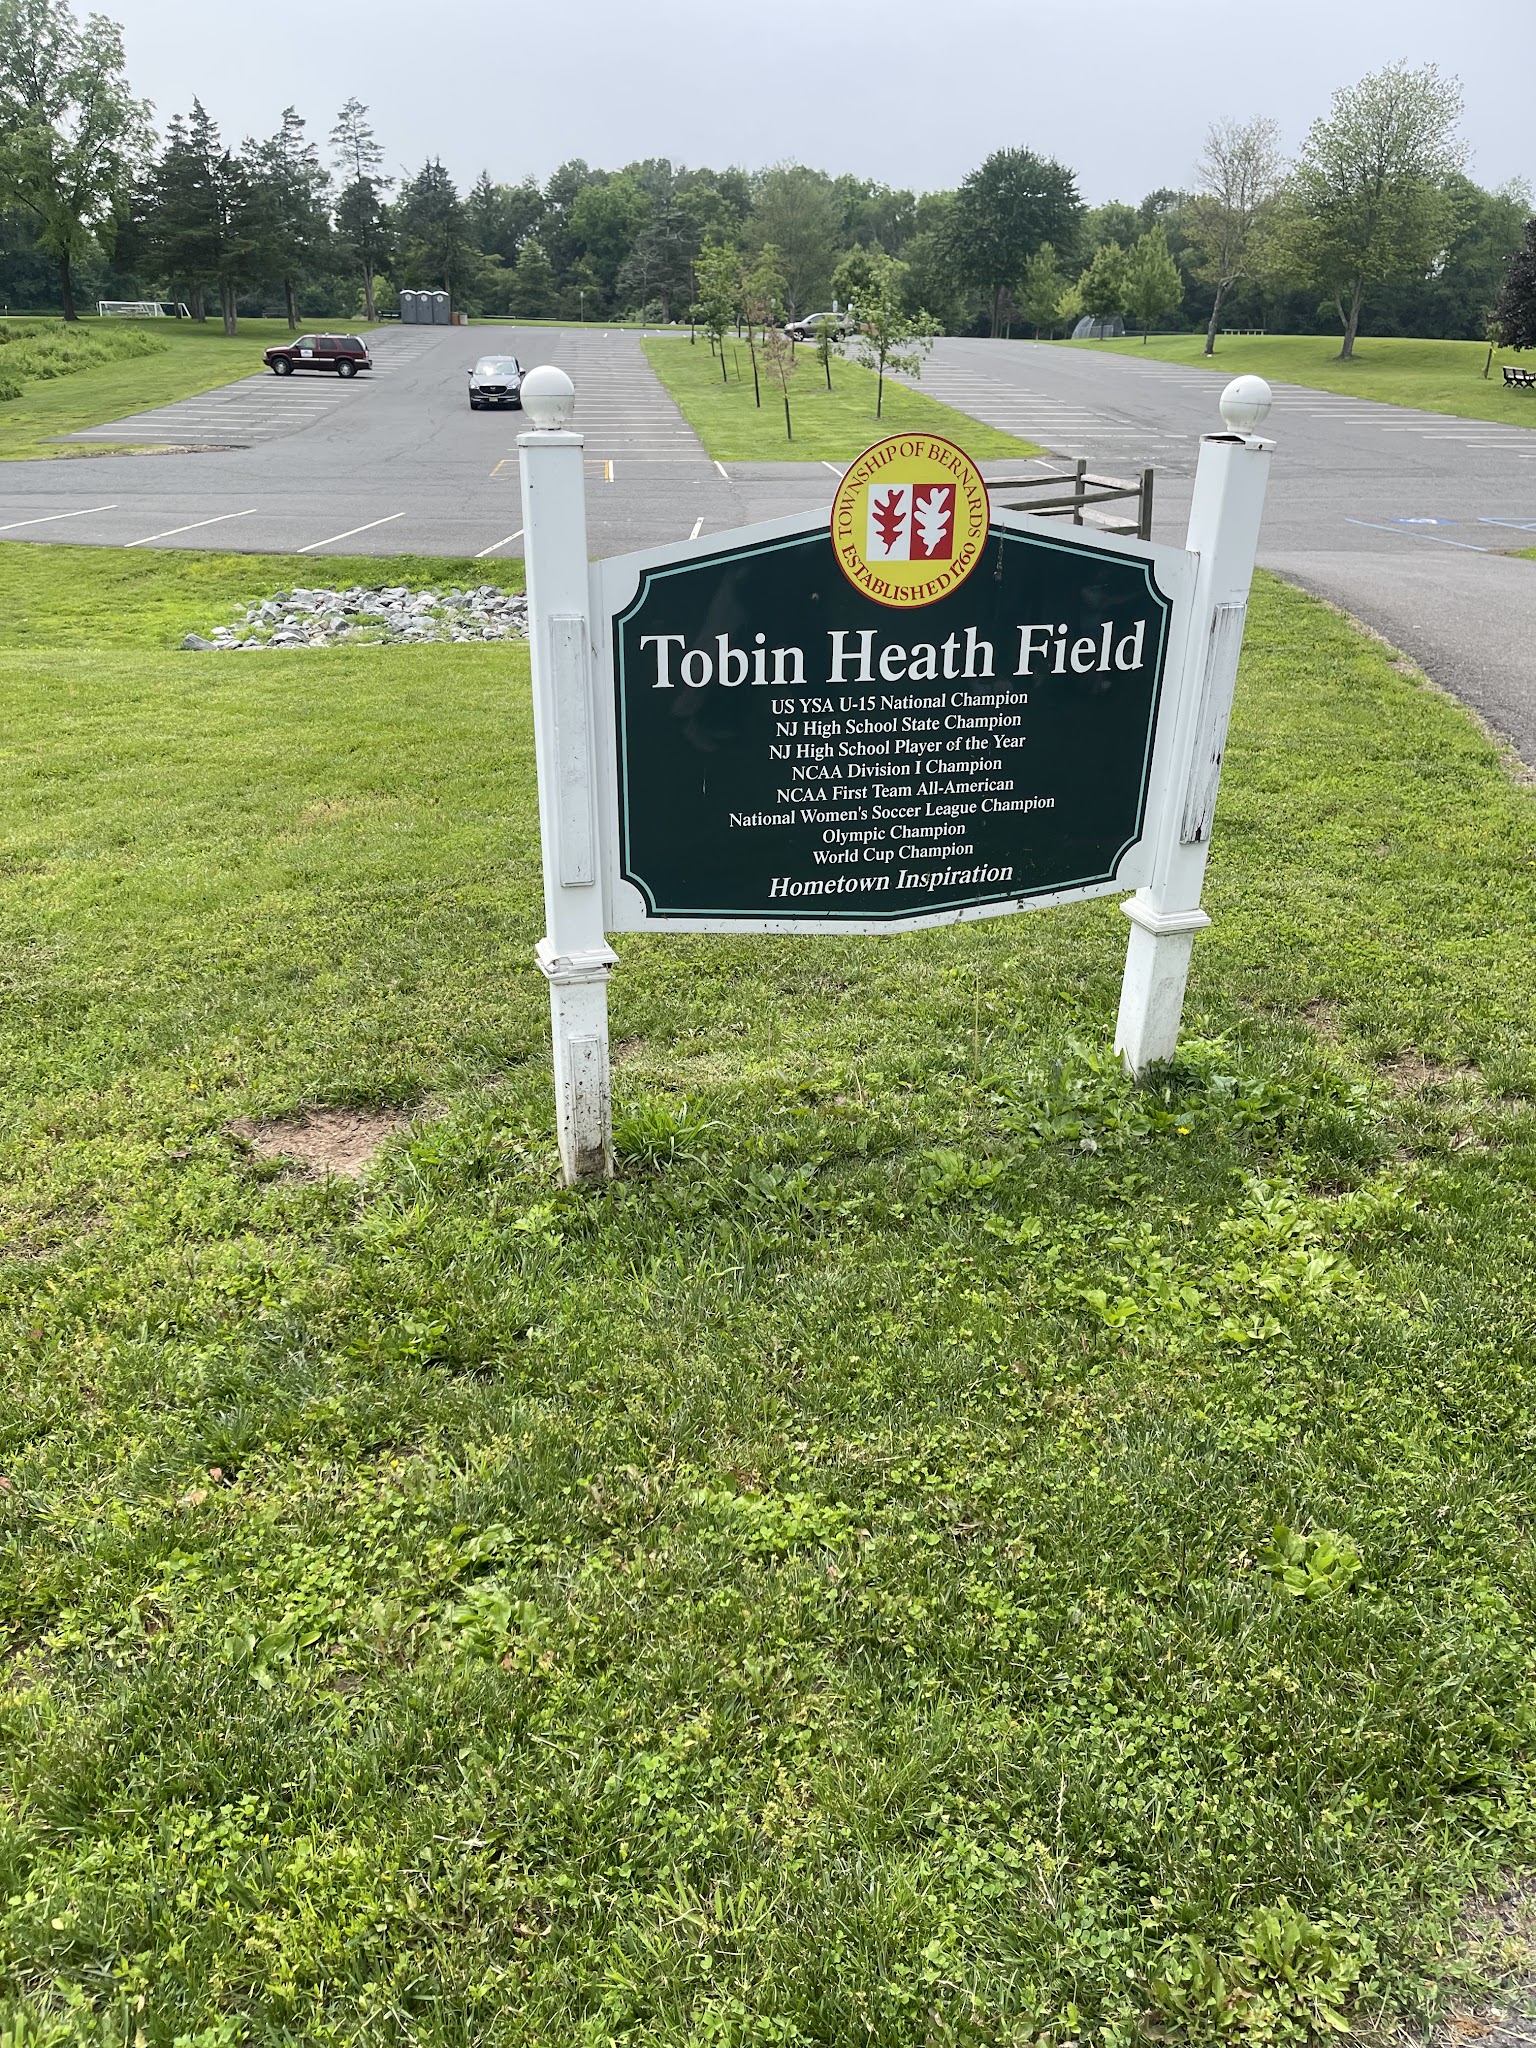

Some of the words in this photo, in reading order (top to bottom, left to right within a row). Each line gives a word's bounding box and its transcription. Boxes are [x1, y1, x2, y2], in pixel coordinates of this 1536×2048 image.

[838, 445, 896, 540] TOWNSHIP
[900, 441, 925, 458] OF
[927, 443, 983, 539] BERNARDS
[841, 543, 951, 601] ESTABLISHED
[949, 542, 976, 579] 1760
[640, 633, 807, 688] Tobin
[826, 627, 995, 682] Heath
[1013, 620, 1145, 675] Field
[772, 699, 794, 714] US
[799, 698, 834, 713] YSA
[840, 696, 875, 711] U-15
[881, 693, 945, 710] National
[951, 691, 1027, 708] Champion
[776, 722, 798, 736] NJ
[804, 720, 841, 738] High
[846, 718, 897, 734] School
[902, 717, 939, 731] State
[945, 713, 1021, 731] Champion
[770, 745, 791, 759] NJ
[796, 743, 833, 761] High
[839, 740, 889, 756] School
[895, 739, 942, 756] Player
[946, 737, 963, 751] of
[965, 736, 988, 750] the
[993, 735, 1026, 748] Year
[792, 765, 842, 780] NCAA
[848, 762, 910, 777] Division
[915, 761, 921, 774] I
[926, 757, 1001, 774] Champion
[777, 788, 827, 803] NCAA
[833, 786, 867, 800] First
[872, 784, 911, 798] Team
[916, 778, 1013, 795] All-American
[729, 810, 795, 827] National
[800, 806, 867, 823] Women's
[872, 806, 921, 819] Soccer
[926, 803, 977, 817] League
[982, 796, 1054, 813] Champion
[823, 827, 885, 845] Olympic
[890, 823, 965, 839] Champion
[813, 849, 858, 864] World
[864, 848, 894, 863] Cup
[899, 843, 973, 859] Champion
[768, 876, 889, 897] Hometown
[896, 864, 1013, 891] Inspiration
